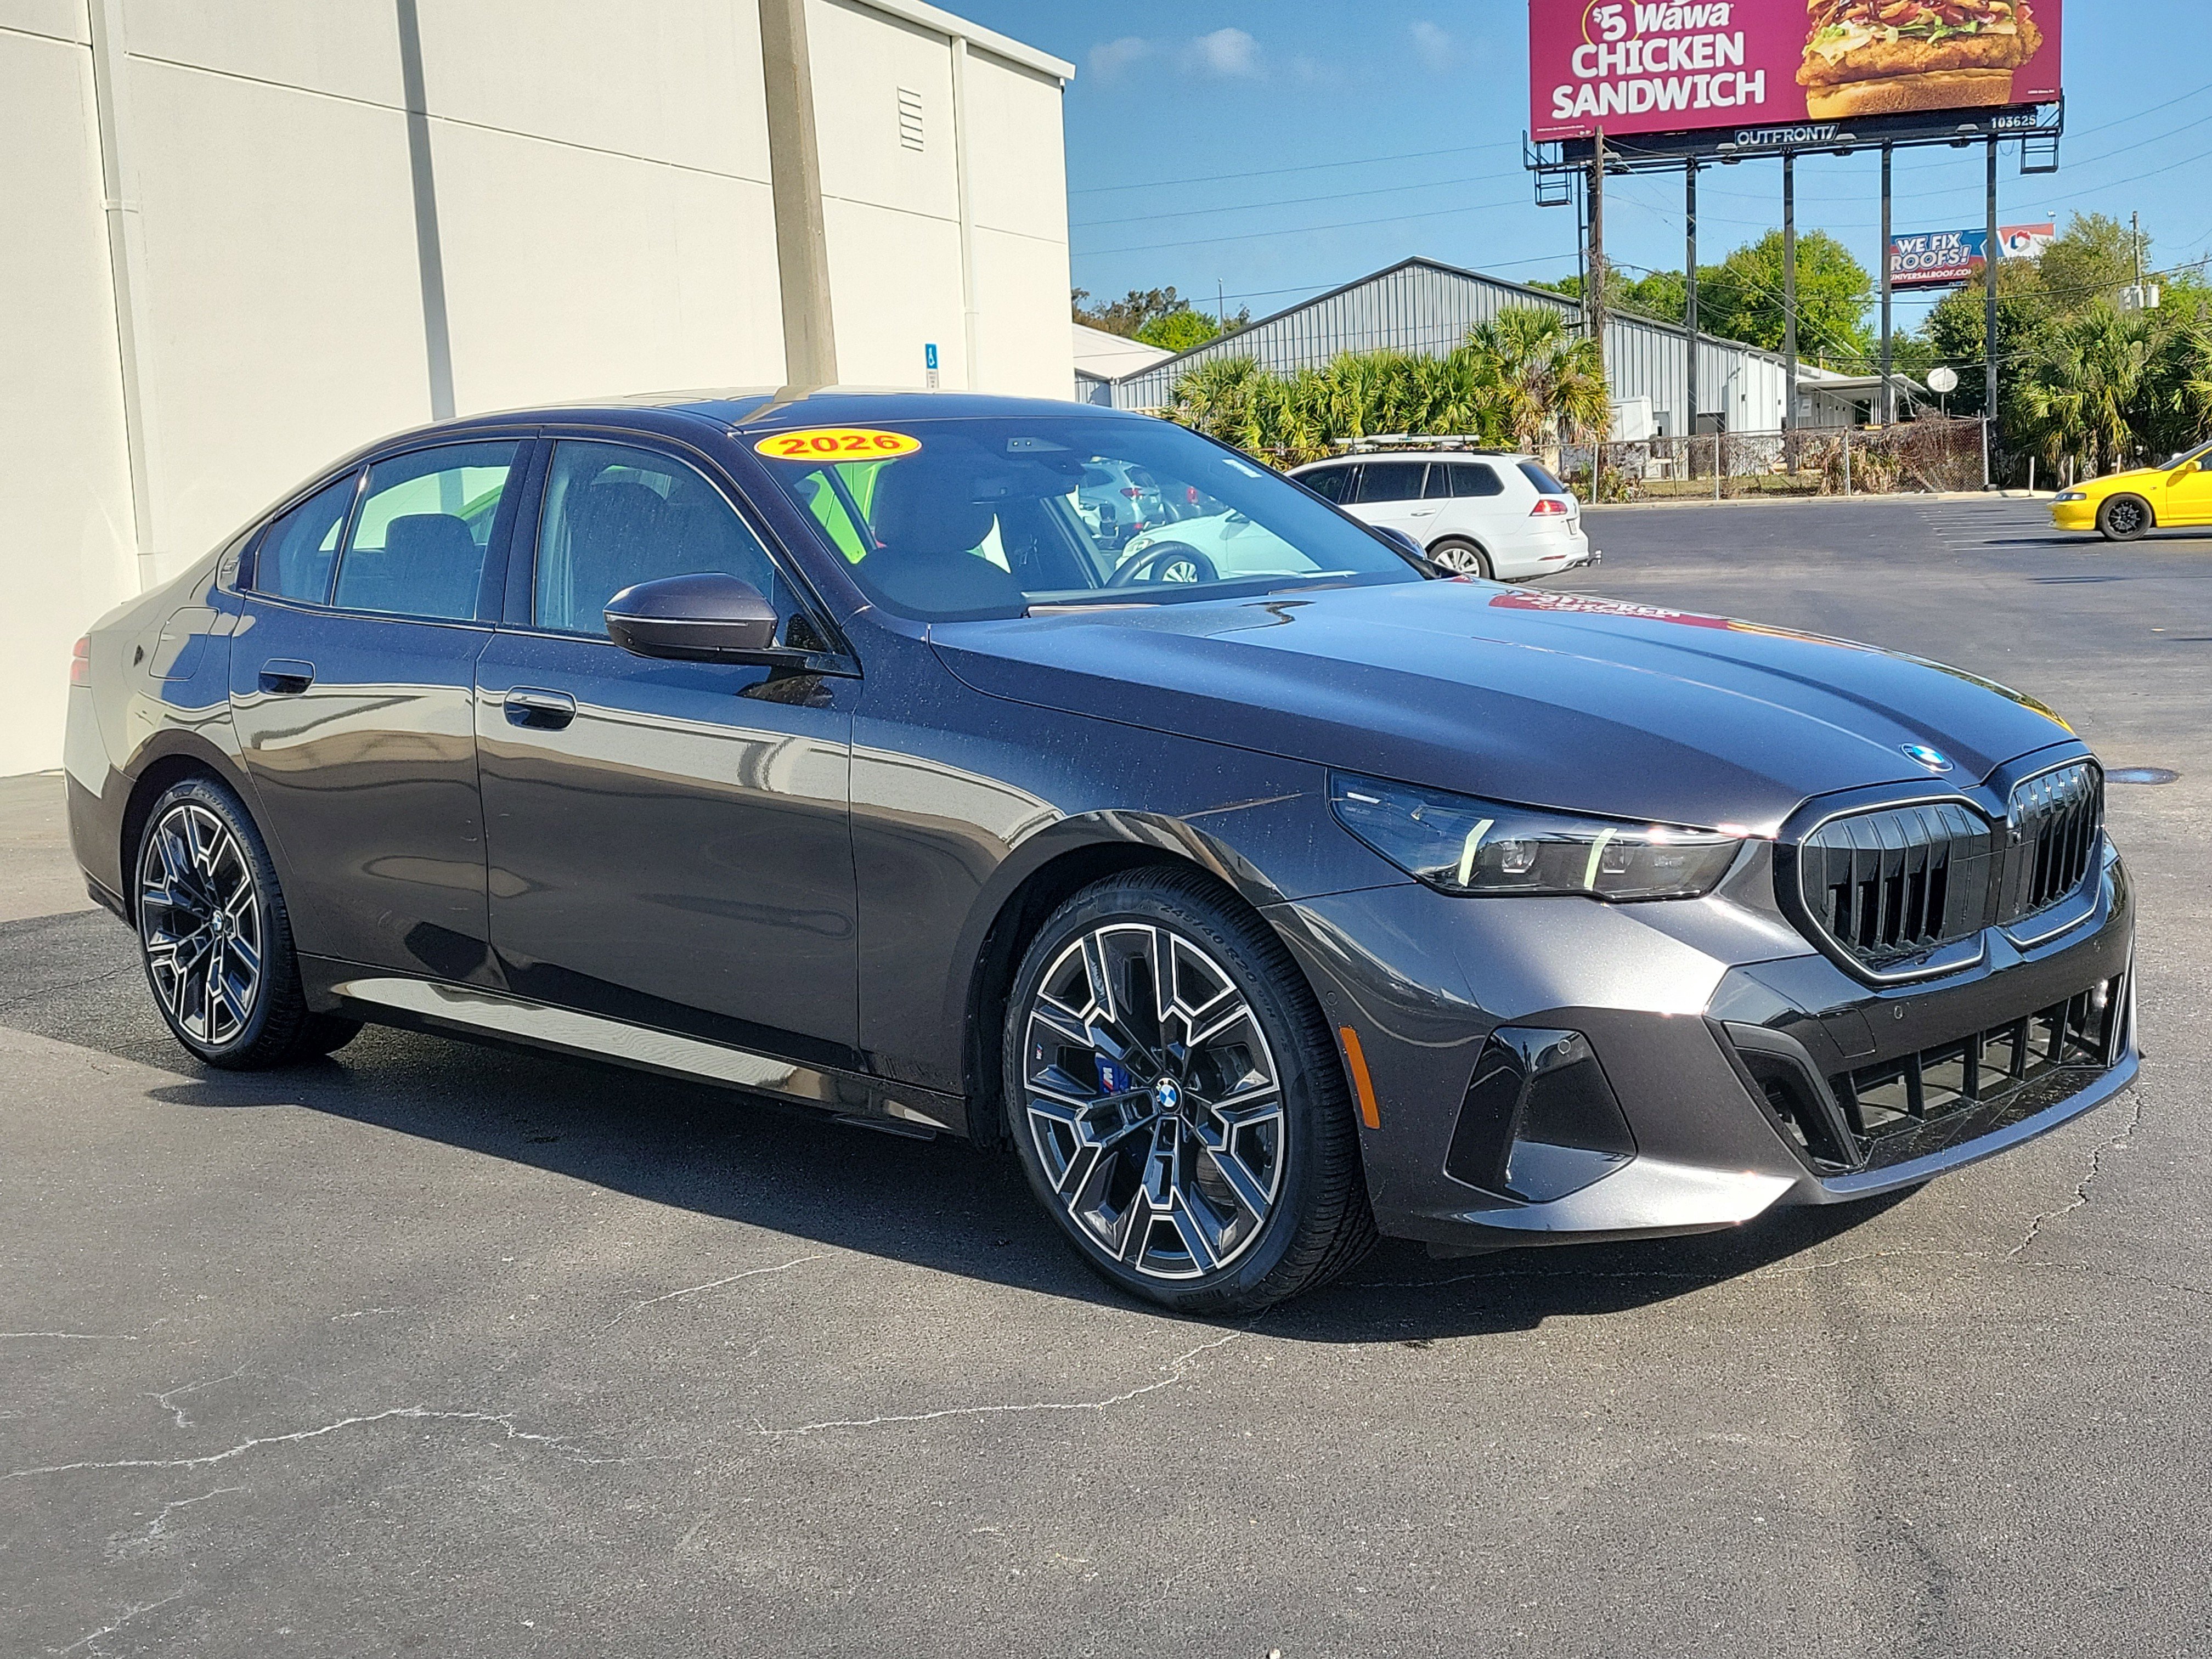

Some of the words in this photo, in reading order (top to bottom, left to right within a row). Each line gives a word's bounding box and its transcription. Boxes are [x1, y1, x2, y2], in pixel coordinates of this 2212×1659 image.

[1592, 4, 1627, 41] $5
[1634, 2, 1730, 33] Wawa
[1572, 32, 1744, 78] CHICKEN
[1552, 70, 1765, 119] SANDWICH
[1891, 247, 1970, 271] ROOFS!
[1897, 237, 1926, 254] WE
[1932, 233, 1961, 250] FIX
[1891, 269, 1972, 281] UNIVERSALROOF.CO
[778, 435, 902, 455] 2026
[1159, 905, 1225, 945] 245/40
[1225, 947, 1257, 983] R20
